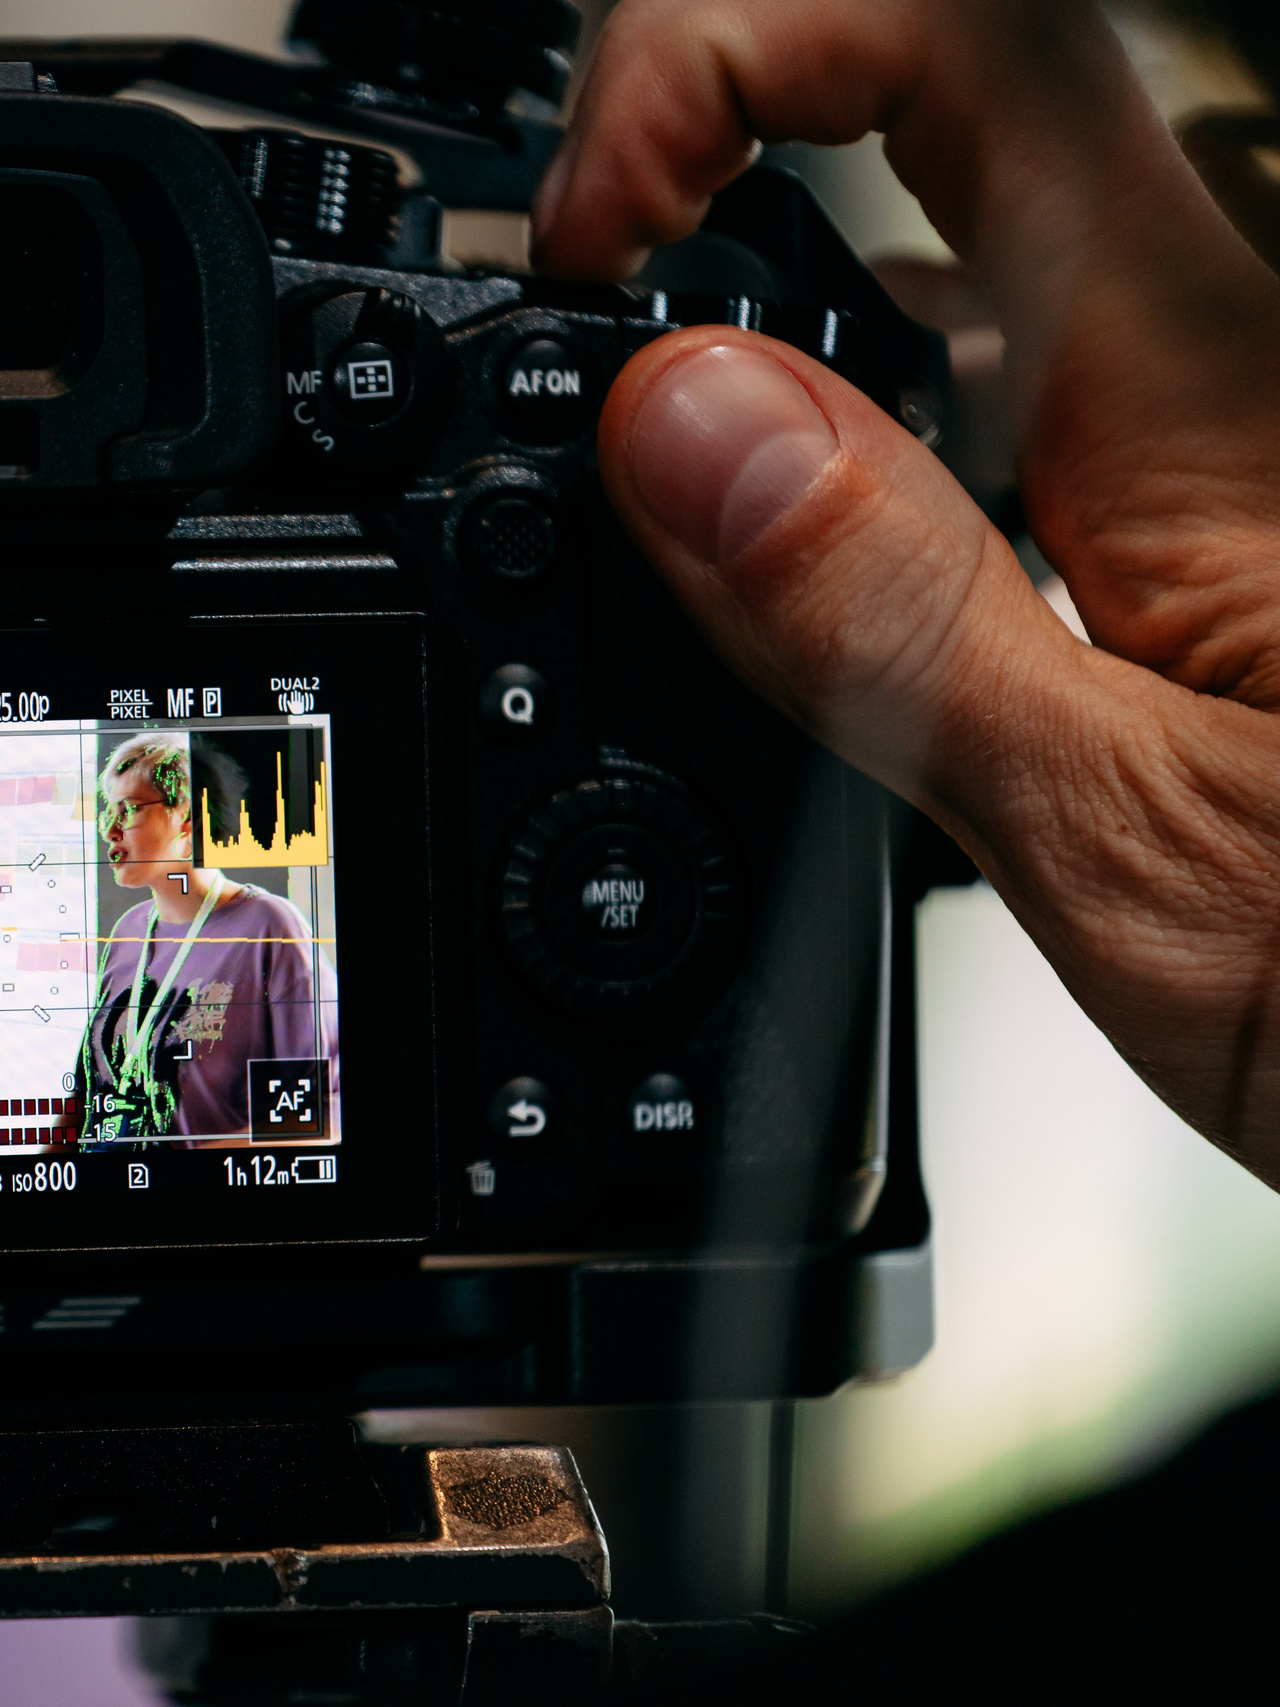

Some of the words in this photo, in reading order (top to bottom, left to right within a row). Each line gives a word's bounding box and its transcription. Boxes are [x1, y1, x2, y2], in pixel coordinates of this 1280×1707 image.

[286, 371, 321, 394] MF
[293, 401, 315, 425] C
[312, 429, 334, 451] S
[270, 677, 320, 692] DUAL2
[110, 689, 149, 703] PIXEL
[167, 689, 194, 718] MF
[501, 686, 535, 726] Q
[110, 705, 150, 719] PIXEL
[592, 879, 644, 903] MENU
[601, 905, 639, 929] /SET
[62, 1072, 76, 1092] 0
[84, 1094, 115, 1114] -16
[276, 1090, 305, 1111] AF
[85, 1123, 116, 1143] -15
[133, 1168, 144, 1185] 2
[224, 1156, 246, 1187] 1h
[250, 1155, 289, 1186] 12m
